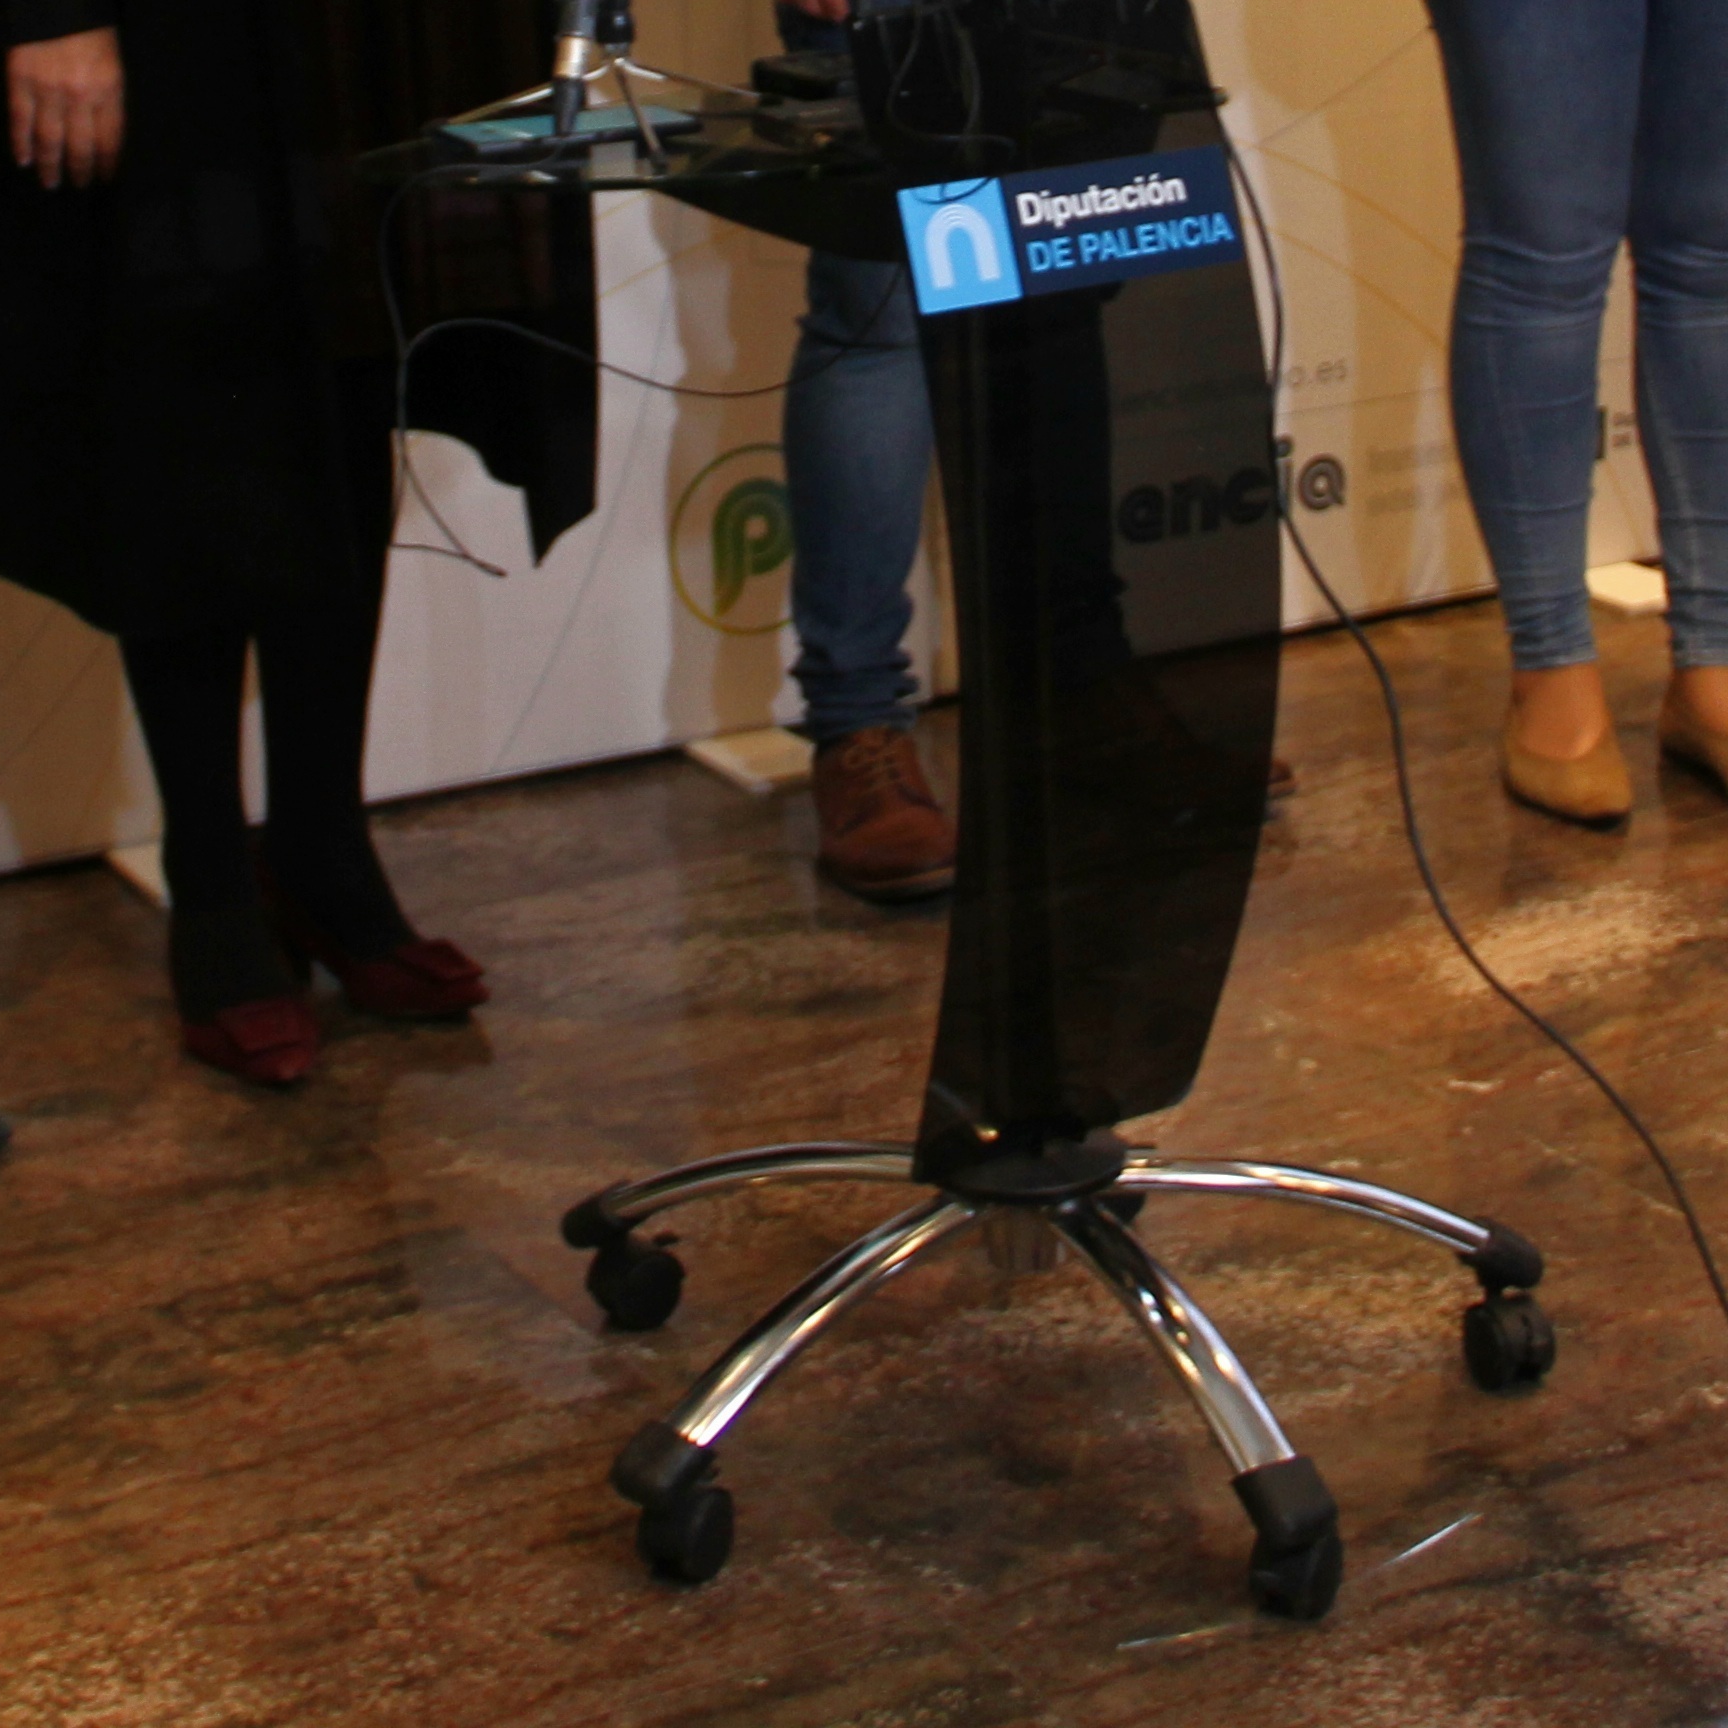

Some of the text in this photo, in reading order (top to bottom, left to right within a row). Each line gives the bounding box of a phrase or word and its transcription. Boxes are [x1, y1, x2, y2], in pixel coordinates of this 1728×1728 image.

[1016, 172, 1188, 229] Diputación
[1026, 211, 1235, 272] DE PALENCIA
[1119, 435, 1347, 545] encia
